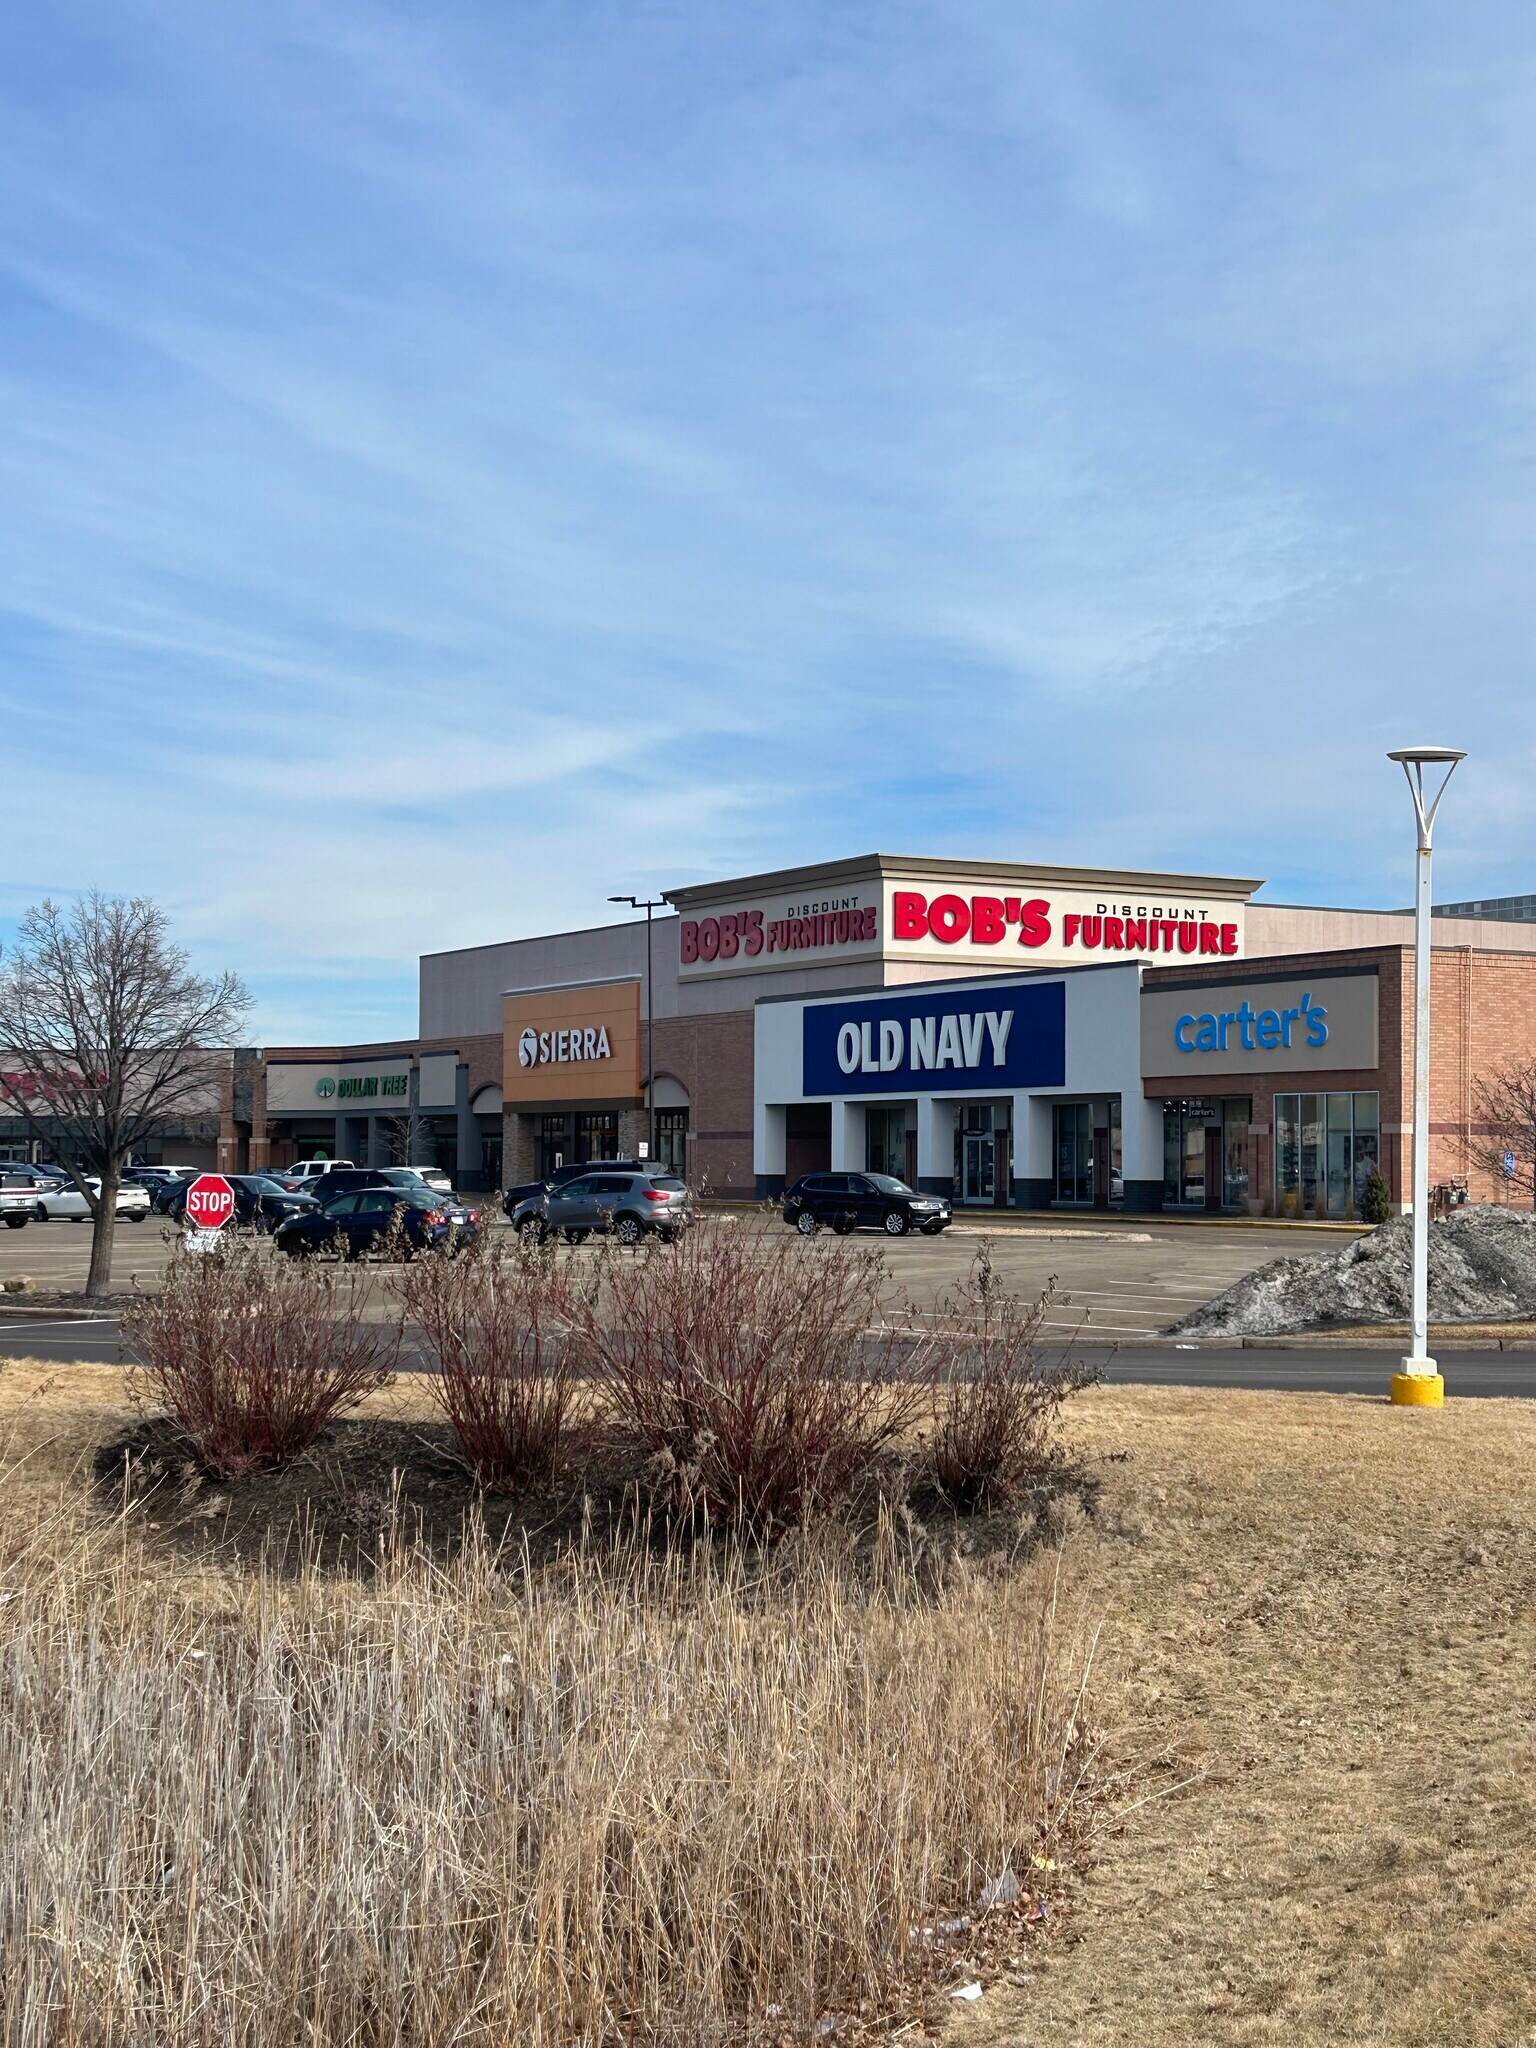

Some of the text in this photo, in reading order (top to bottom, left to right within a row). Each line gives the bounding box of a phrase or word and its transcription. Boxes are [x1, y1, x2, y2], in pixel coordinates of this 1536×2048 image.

[788, 897, 859, 918] DISCOUNT
[893, 891, 1239, 956] BOB'S FURNITURE
[1096, 903, 1209, 921] DISCOUNT
[680, 906, 877, 964] BOB'S FURNITURE
[1175, 992, 1330, 1053] carter's
[539, 1025, 612, 1064] SIERRA
[836, 1010, 1015, 1075] OLD NAVY
[338, 1074, 409, 1099] DOLLAR TREE
[189, 1190, 232, 1213] STOP
